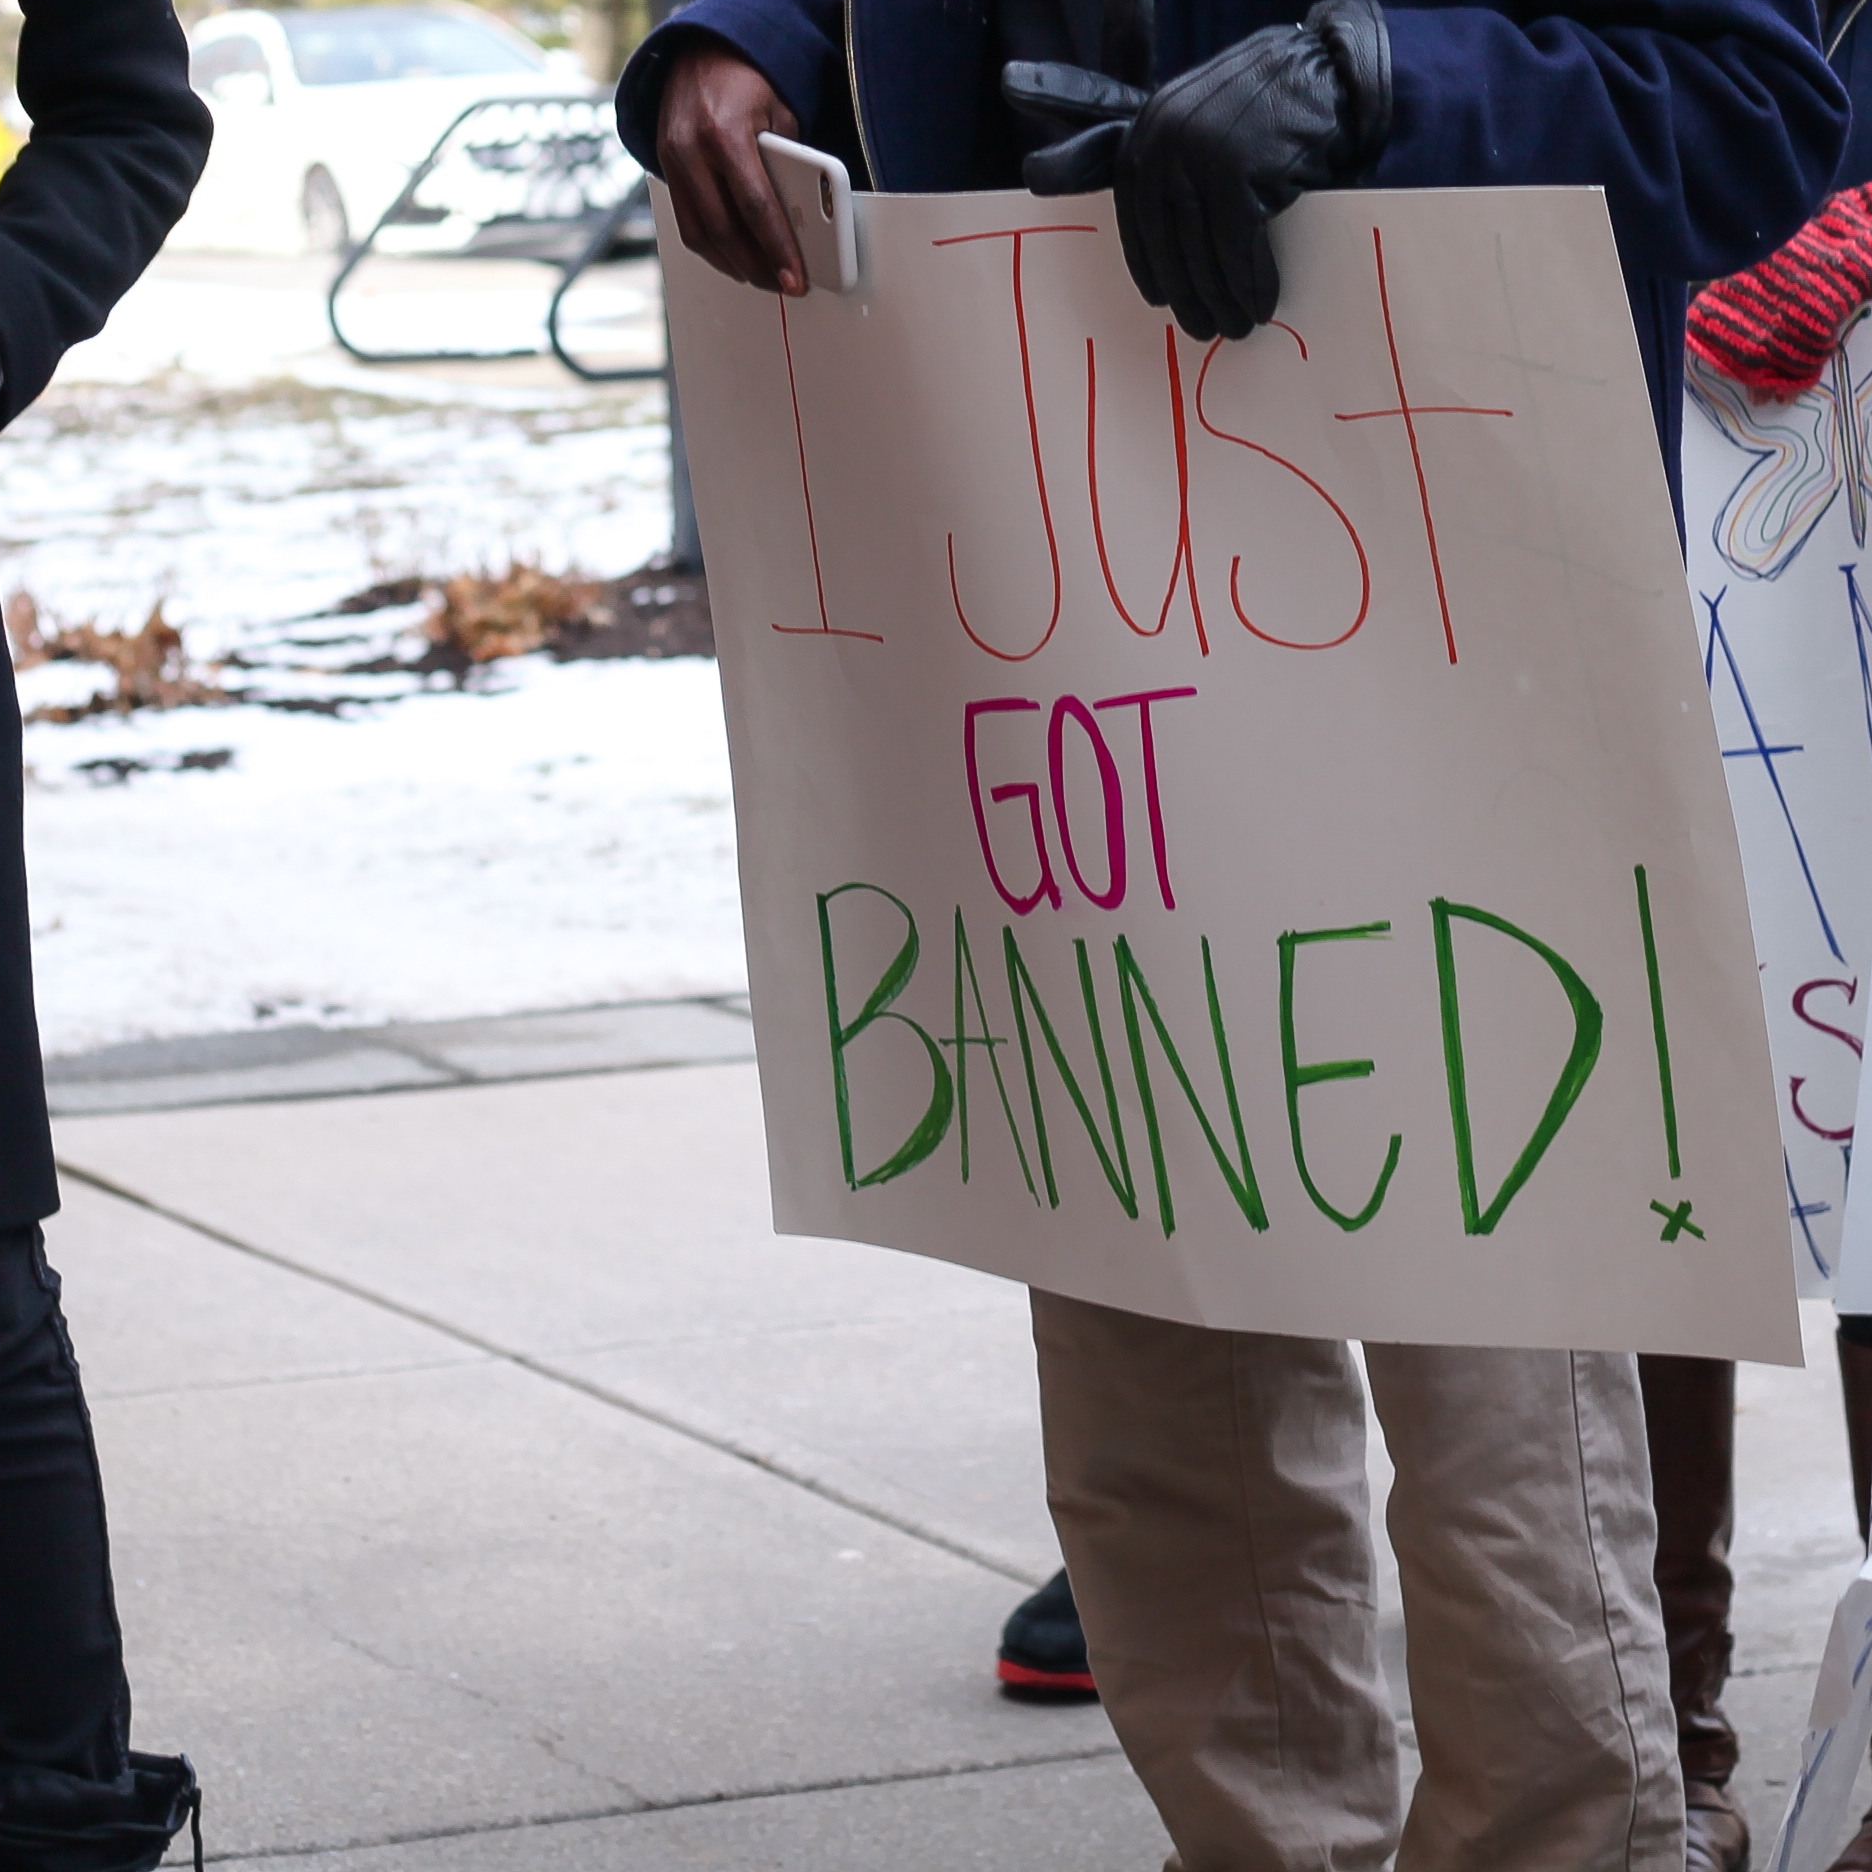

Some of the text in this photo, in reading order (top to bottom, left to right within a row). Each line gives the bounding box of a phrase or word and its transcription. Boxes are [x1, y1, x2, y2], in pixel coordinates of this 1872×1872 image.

[769, 294, 885, 644] I
[964, 687, 1198, 914] GOT
[816, 864, 1706, 1243] BANNED!
